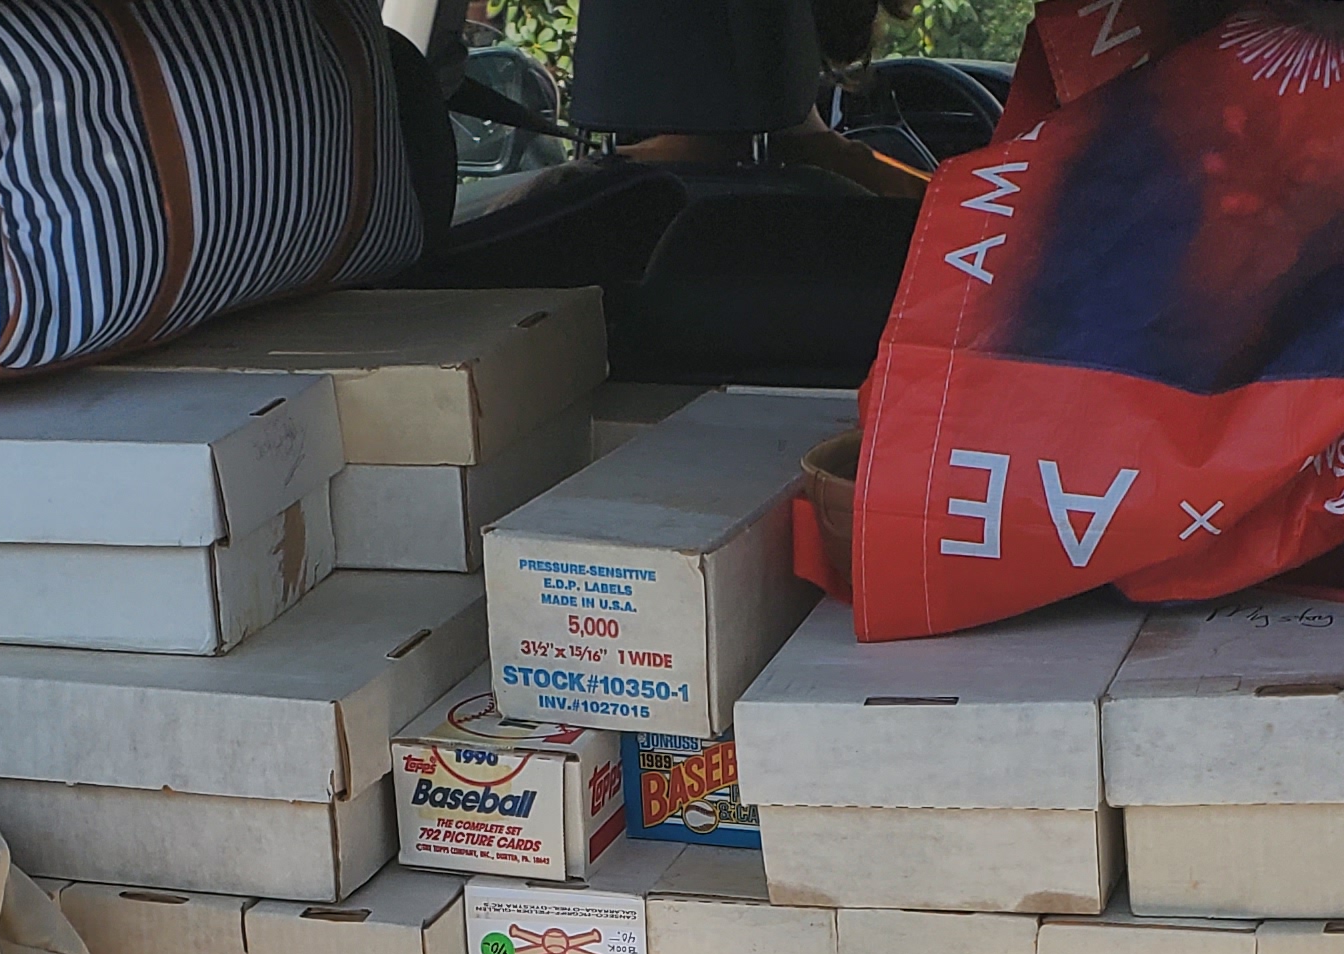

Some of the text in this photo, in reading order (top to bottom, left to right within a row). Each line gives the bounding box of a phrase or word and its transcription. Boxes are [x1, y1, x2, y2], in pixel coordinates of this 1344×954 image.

[940, 449, 1139, 566] AE
[519, 559, 656, 581] PRESSURE-SENSITIVE
[544, 578, 632, 596] E.D.P. LABELS
[541, 593, 637, 612] MADE IN U.S.A.
[568, 615, 619, 639] 5,000
[555, 647, 567, 658] x
[618, 650, 624, 664] 1
[629, 651, 673, 669] WIDE
[503, 665, 689, 702] STOCK#10350-1
[539, 695, 650, 718] INV.#1027015
[456, 748, 499, 766] 1990
[641, 753, 672, 769] 1989
[641, 741, 737, 828] BASEB
[412, 778, 537, 819] Baseball
[436, 818, 522, 836] THE COMPLETE SET
[419, 827, 541, 852] 792 PICTURE CARDS
